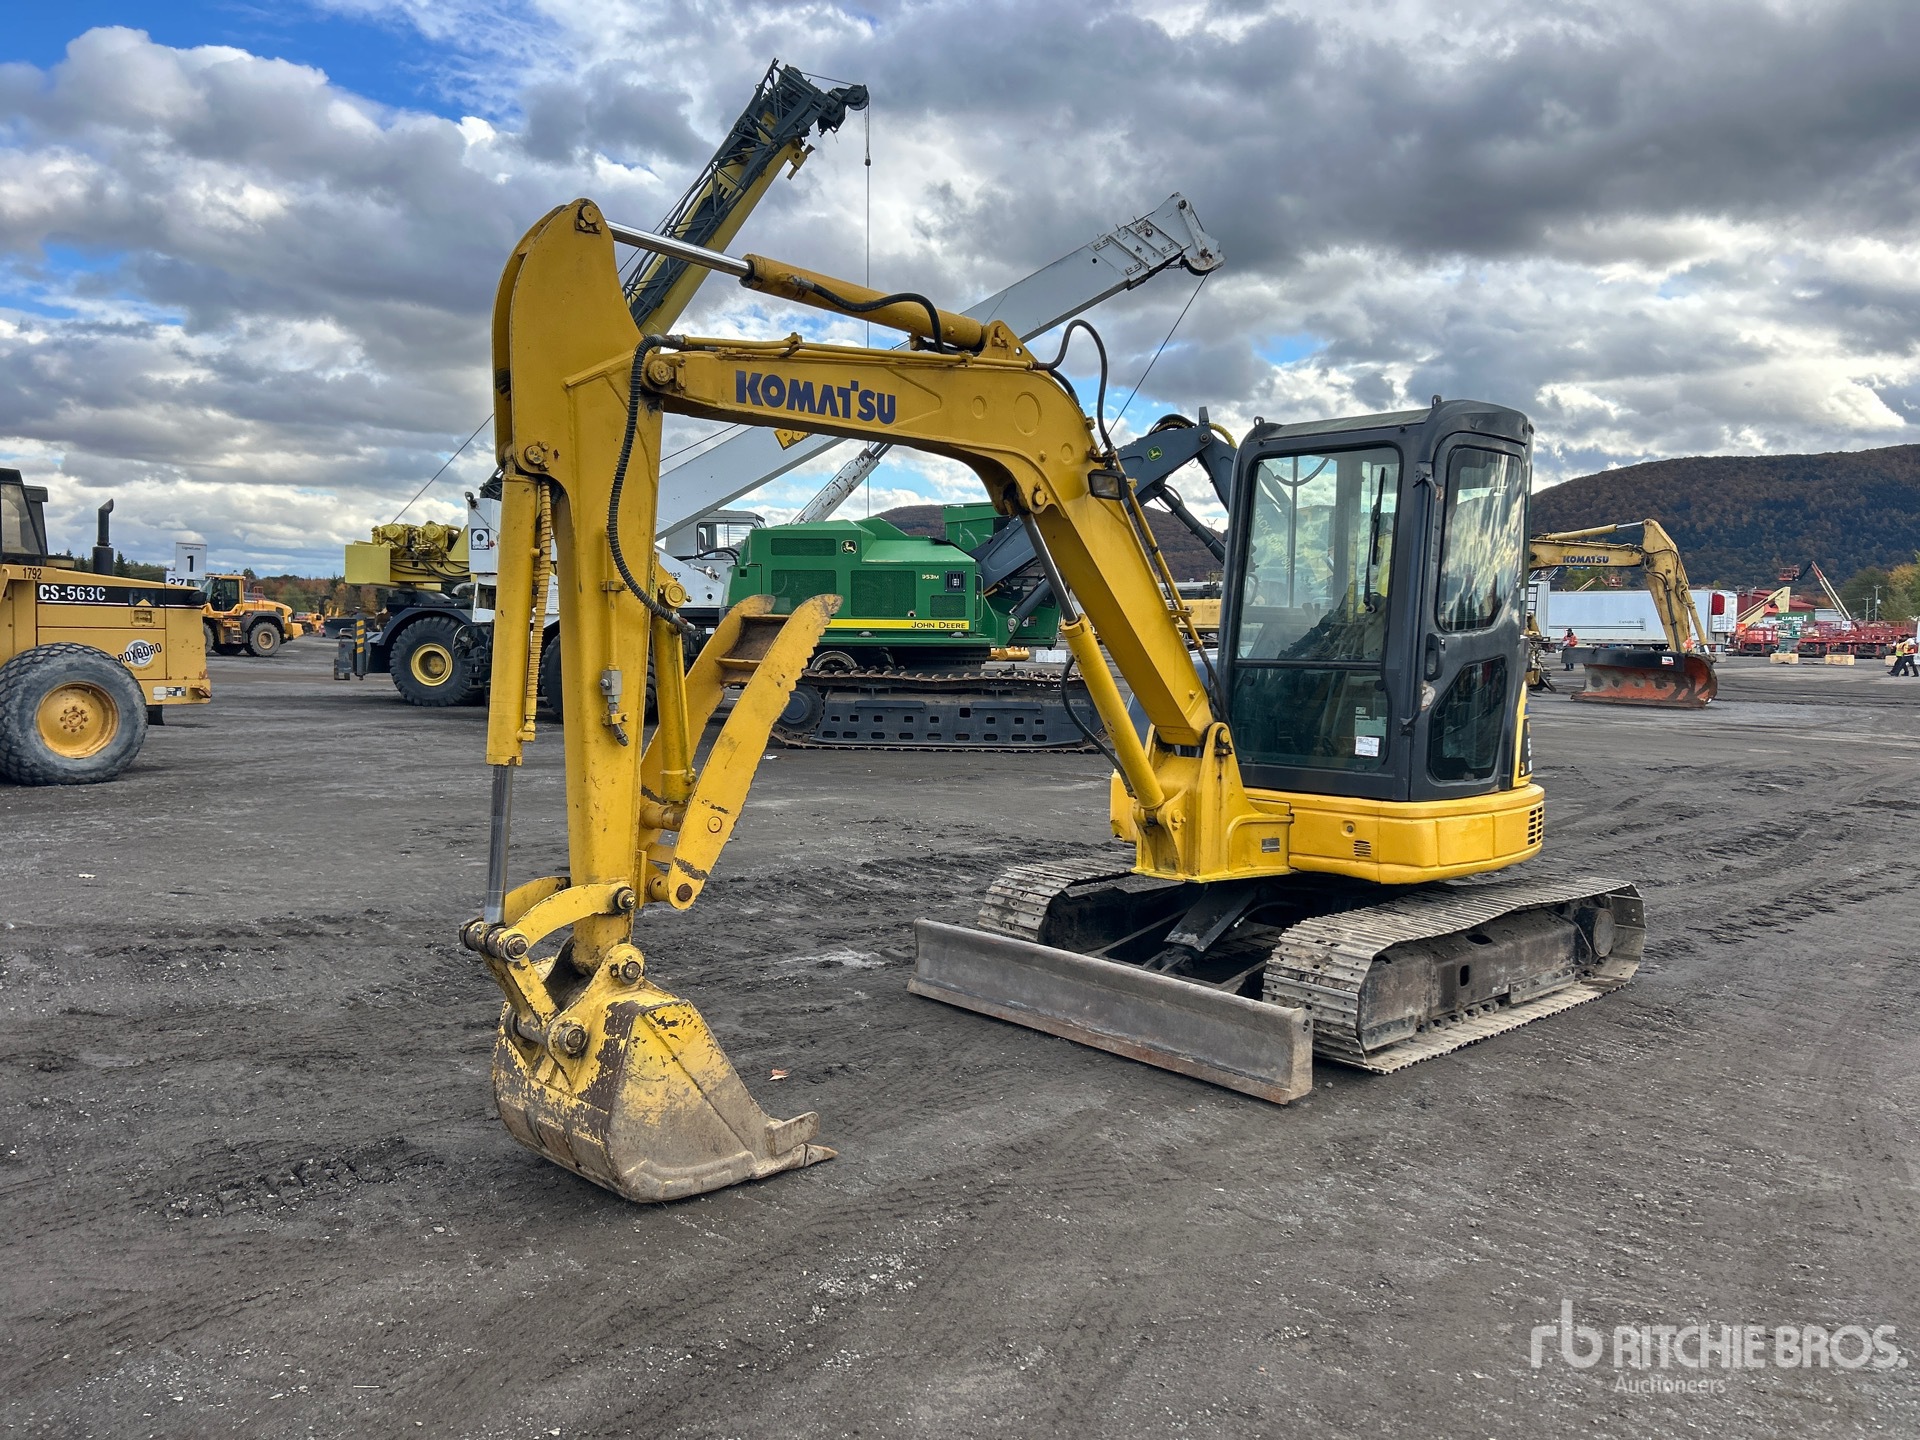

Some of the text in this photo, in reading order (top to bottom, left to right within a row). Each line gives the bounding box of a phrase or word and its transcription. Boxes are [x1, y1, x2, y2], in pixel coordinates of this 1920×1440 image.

[735, 369, 896, 425] KOMATSU
[187, 555, 194, 573] 1
[1562, 555, 1610, 564] KOMATSU
[22, 567, 42, 580] 1792
[39, 584, 106, 601] CS-563C
[911, 621, 966, 629] JOHN DEERE
[117, 643, 163, 664] ROXBORO
